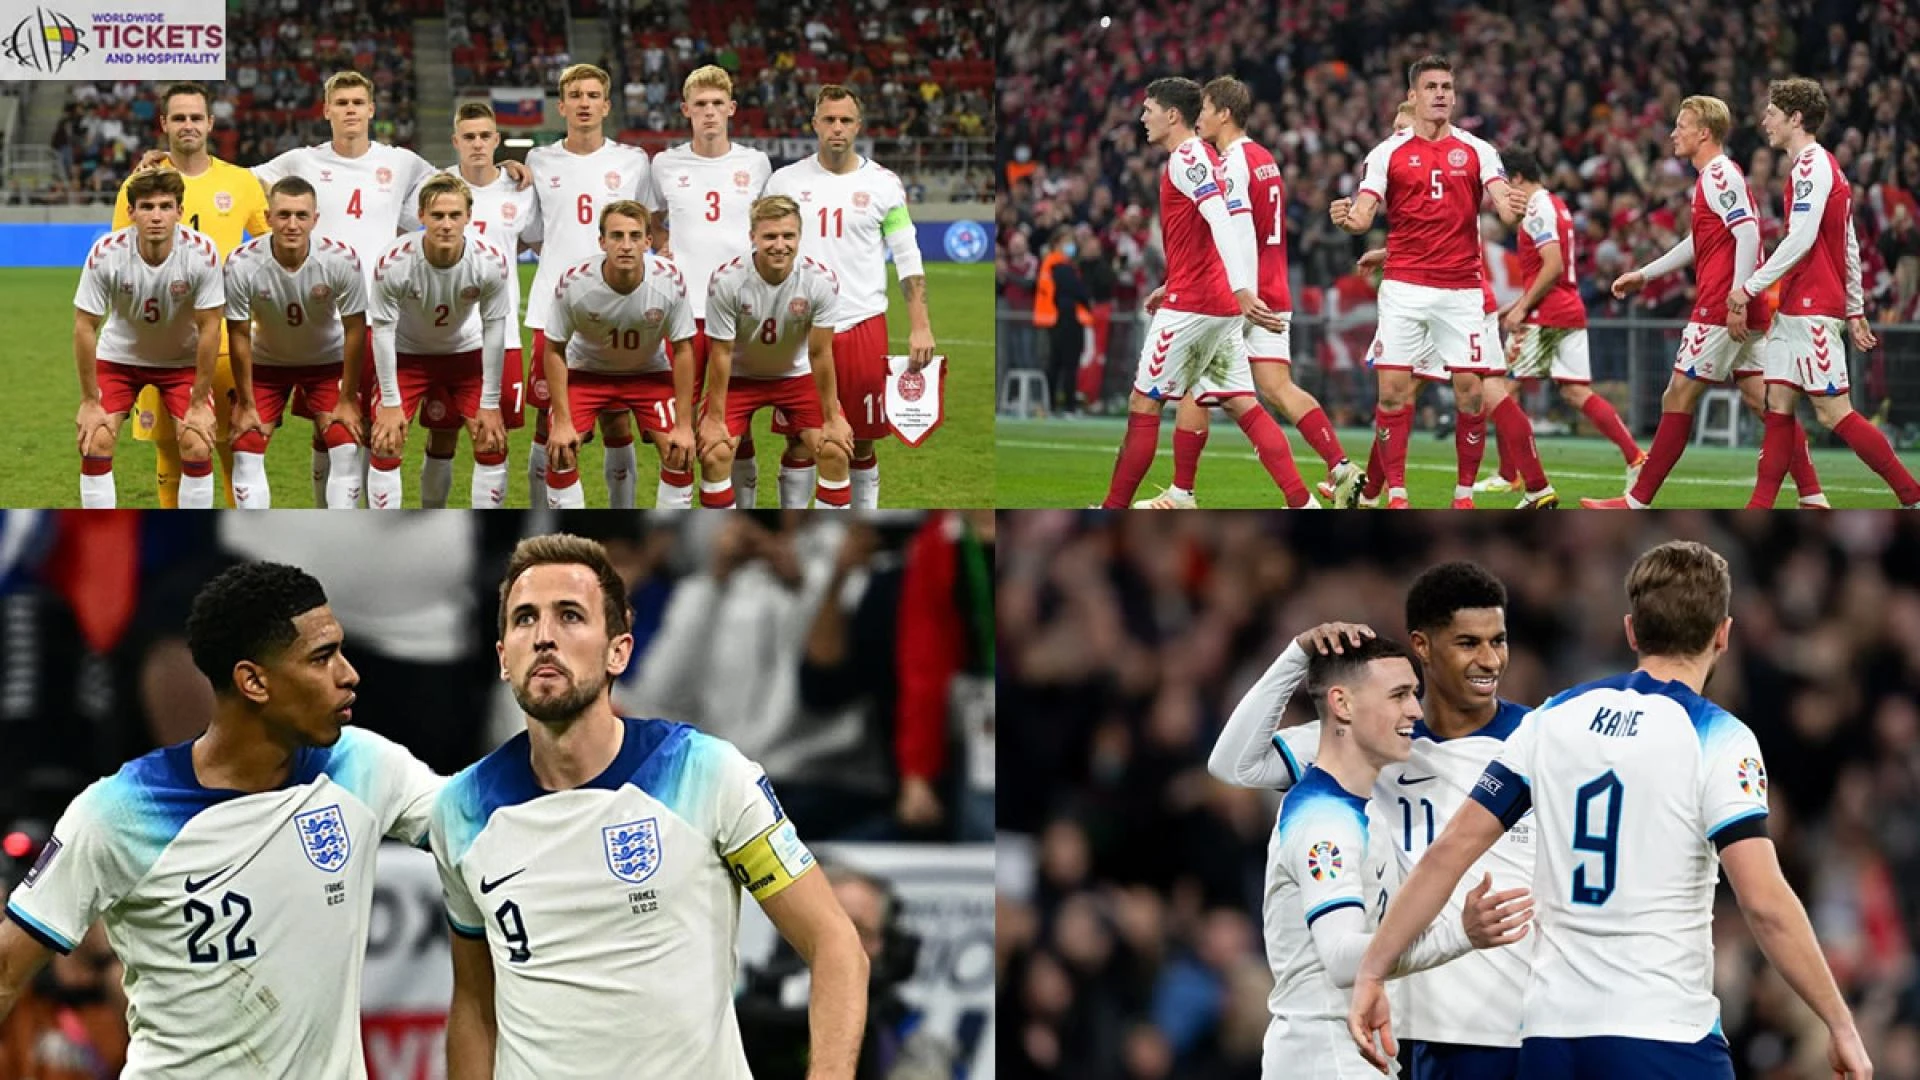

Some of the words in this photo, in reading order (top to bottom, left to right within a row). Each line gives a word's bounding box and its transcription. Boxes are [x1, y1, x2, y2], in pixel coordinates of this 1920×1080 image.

[1431, 169, 1443, 200] 5
[346, 189, 363, 219] 4
[577, 194, 593, 225] 6
[705, 191, 721, 222] 3
[817, 206, 843, 239] 11
[143, 299, 160, 323] 5
[287, 303, 303, 327] 9
[434, 304, 449, 328] 2
[608, 327, 640, 350] 10
[761, 317, 777, 345] 8
[1470, 333, 1481, 363] 5
[1589, 706, 1645, 737] KANE
[1397, 798, 1434, 852] 11
[1571, 768, 1625, 907] 9
[184, 890, 258, 964] 22
[495, 900, 532, 963] 9
